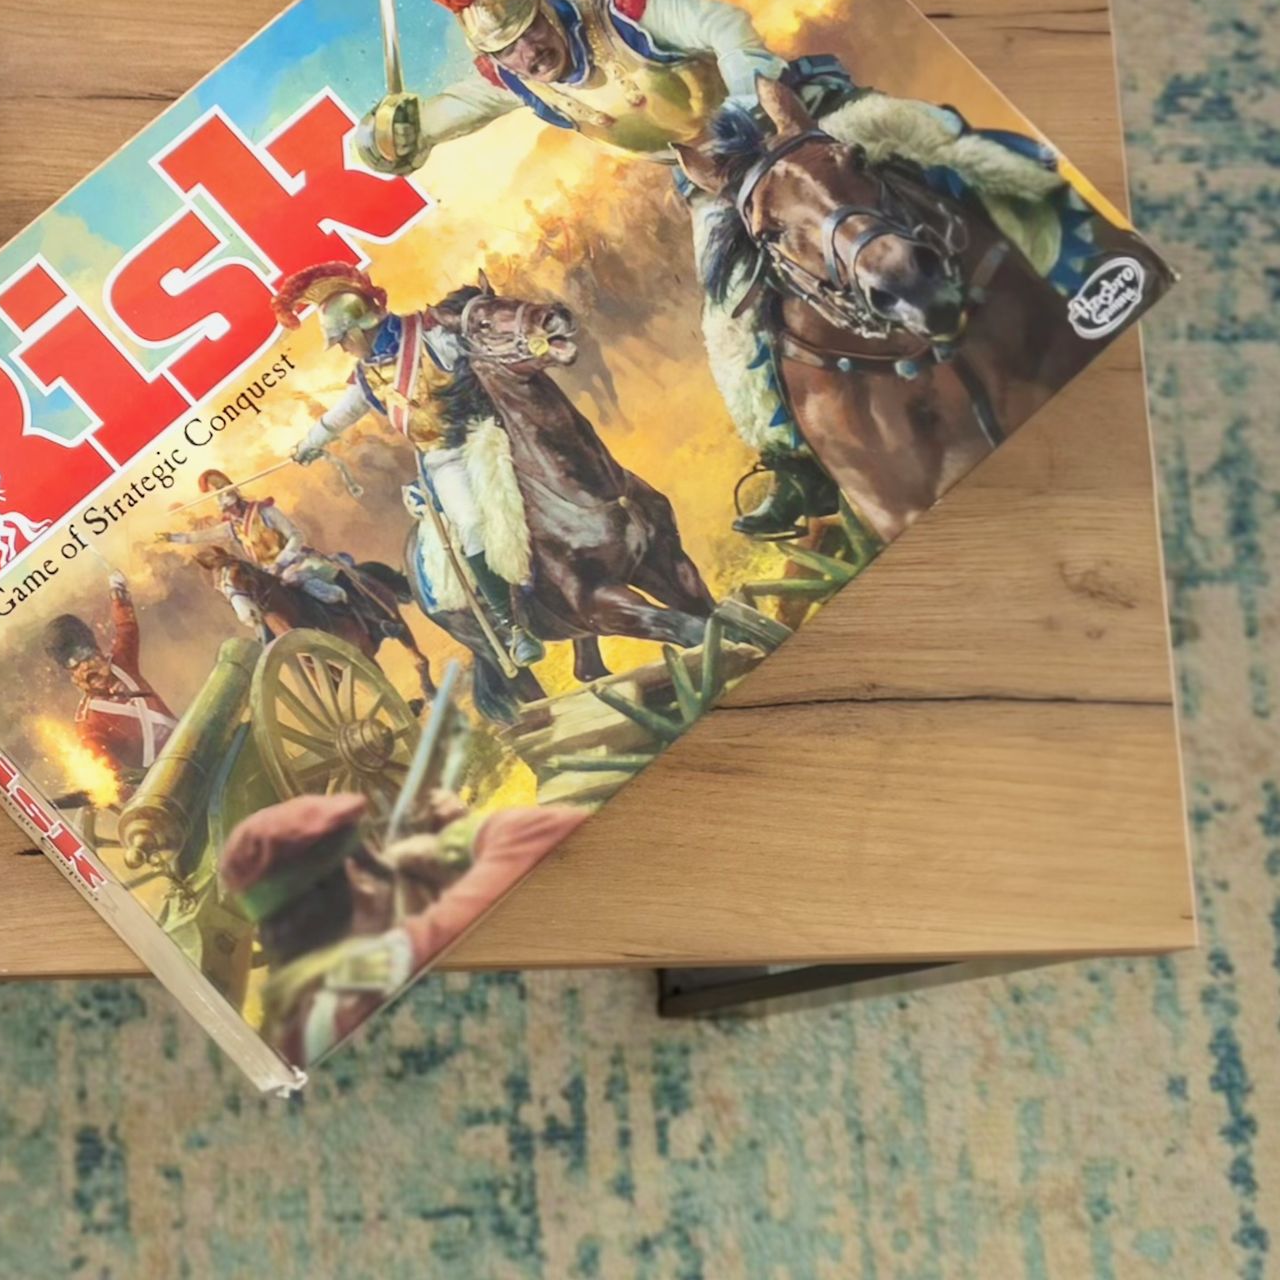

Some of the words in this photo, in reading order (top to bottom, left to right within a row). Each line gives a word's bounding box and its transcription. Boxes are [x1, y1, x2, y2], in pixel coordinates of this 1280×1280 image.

[61, 523, 91, 560] of
[82, 447, 188, 537] Strategic
[183, 350, 296, 449] Conquest
